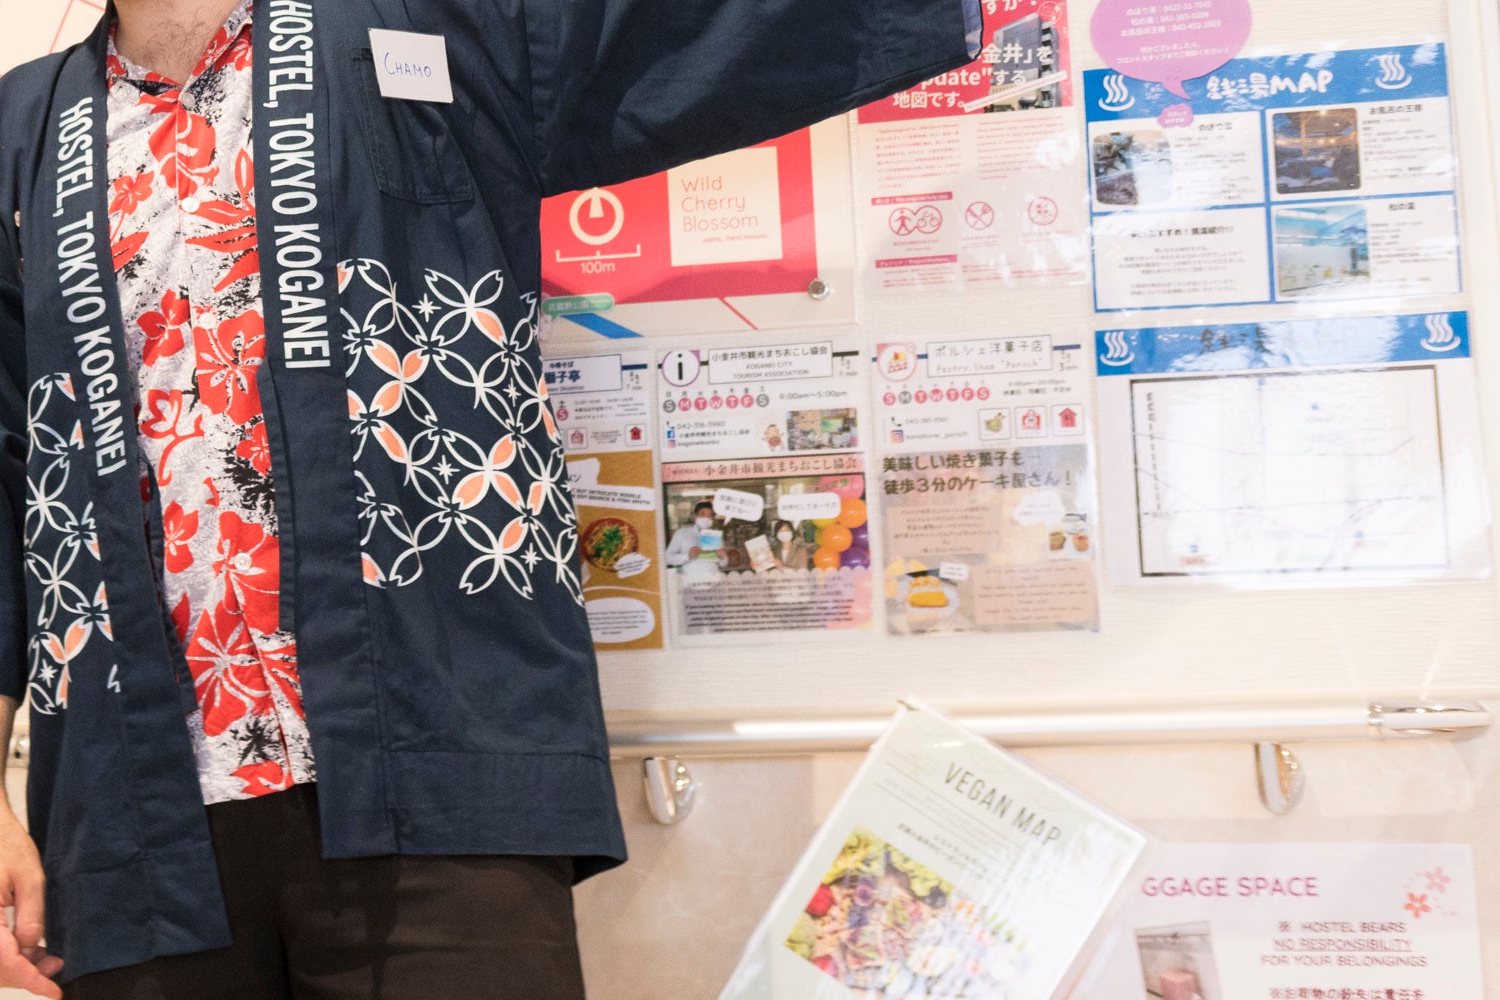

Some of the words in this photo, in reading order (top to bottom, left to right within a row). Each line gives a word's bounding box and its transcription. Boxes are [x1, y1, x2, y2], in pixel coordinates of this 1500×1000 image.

[1206, 69, 1334, 100] 銭湯MAP
[892, 91, 964, 110] 地図です。
[1369, 103, 1424, 116] お風呂の王様
[51, 95, 94, 218] HOSTEL,
[268, 114, 319, 216] TOKYO
[681, 176, 723, 193] Wild
[681, 195, 747, 214] Cherry
[682, 214, 759, 233] Blossom
[56, 211, 107, 324] TOKYO
[580, 261, 616, 274] 100m
[274, 223, 332, 369] KOGANEI
[711, 346, 829, 362] 小金井市観光まちおこし協会
[934, 340, 1044, 358] ポルシェ洋菓子店
[732, 372, 763, 381] TOURISM
[763, 369, 810, 379] ASSOCIATION
[746, 362, 777, 370] KOGANEI
[936, 363, 969, 374] Pastry
[974, 362, 995, 370] Shop
[1059, 362, 1065, 371] 3
[73, 318, 128, 477] KOGANEI
[704, 457, 857, 477] 小金井市観光まちおこし協会
[943, 762, 1012, 820] VEGAN
[1010, 808, 1063, 848] MAP
[1141, 876, 1228, 898] GGAGE
[1237, 876, 1320, 898] SPACE
[1301, 921, 1356, 933] HOSTEL
[1360, 921, 1407, 933] BEARS
[1273, 938, 1295, 950] NO
[1300, 938, 1411, 950] RESPONSIBILITY
[1260, 955, 1290, 966] FOR
[1294, 955, 1334, 967] YOUR
[1336, 955, 1429, 967] BELONGINGS
